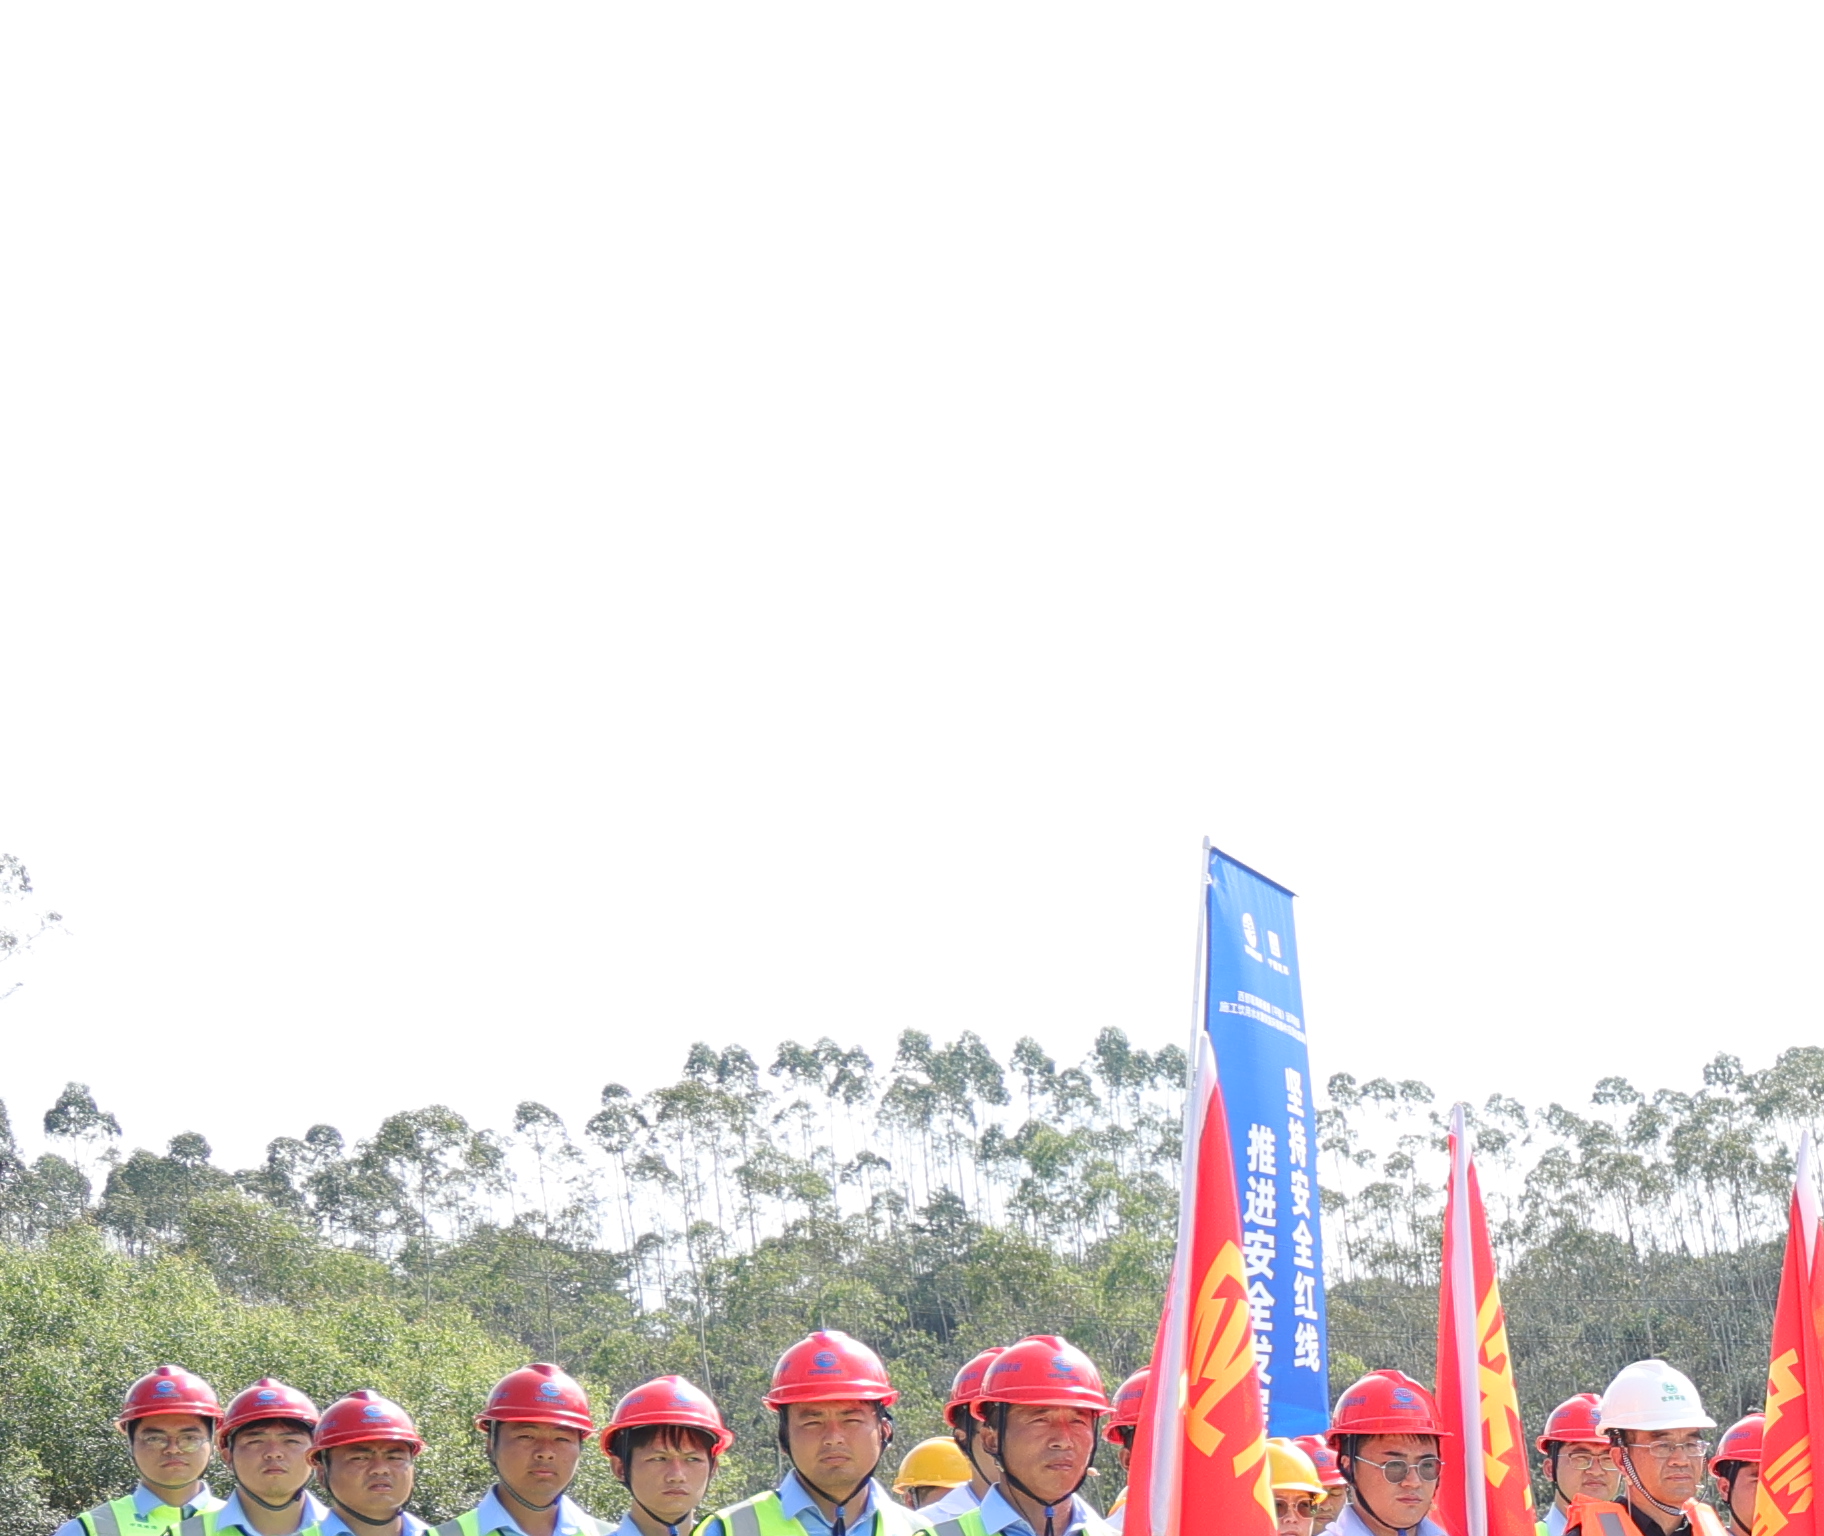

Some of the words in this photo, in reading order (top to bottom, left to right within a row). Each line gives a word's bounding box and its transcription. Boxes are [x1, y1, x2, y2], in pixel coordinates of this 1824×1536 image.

[1284, 1067, 1321, 1373] 坚持安全红线
